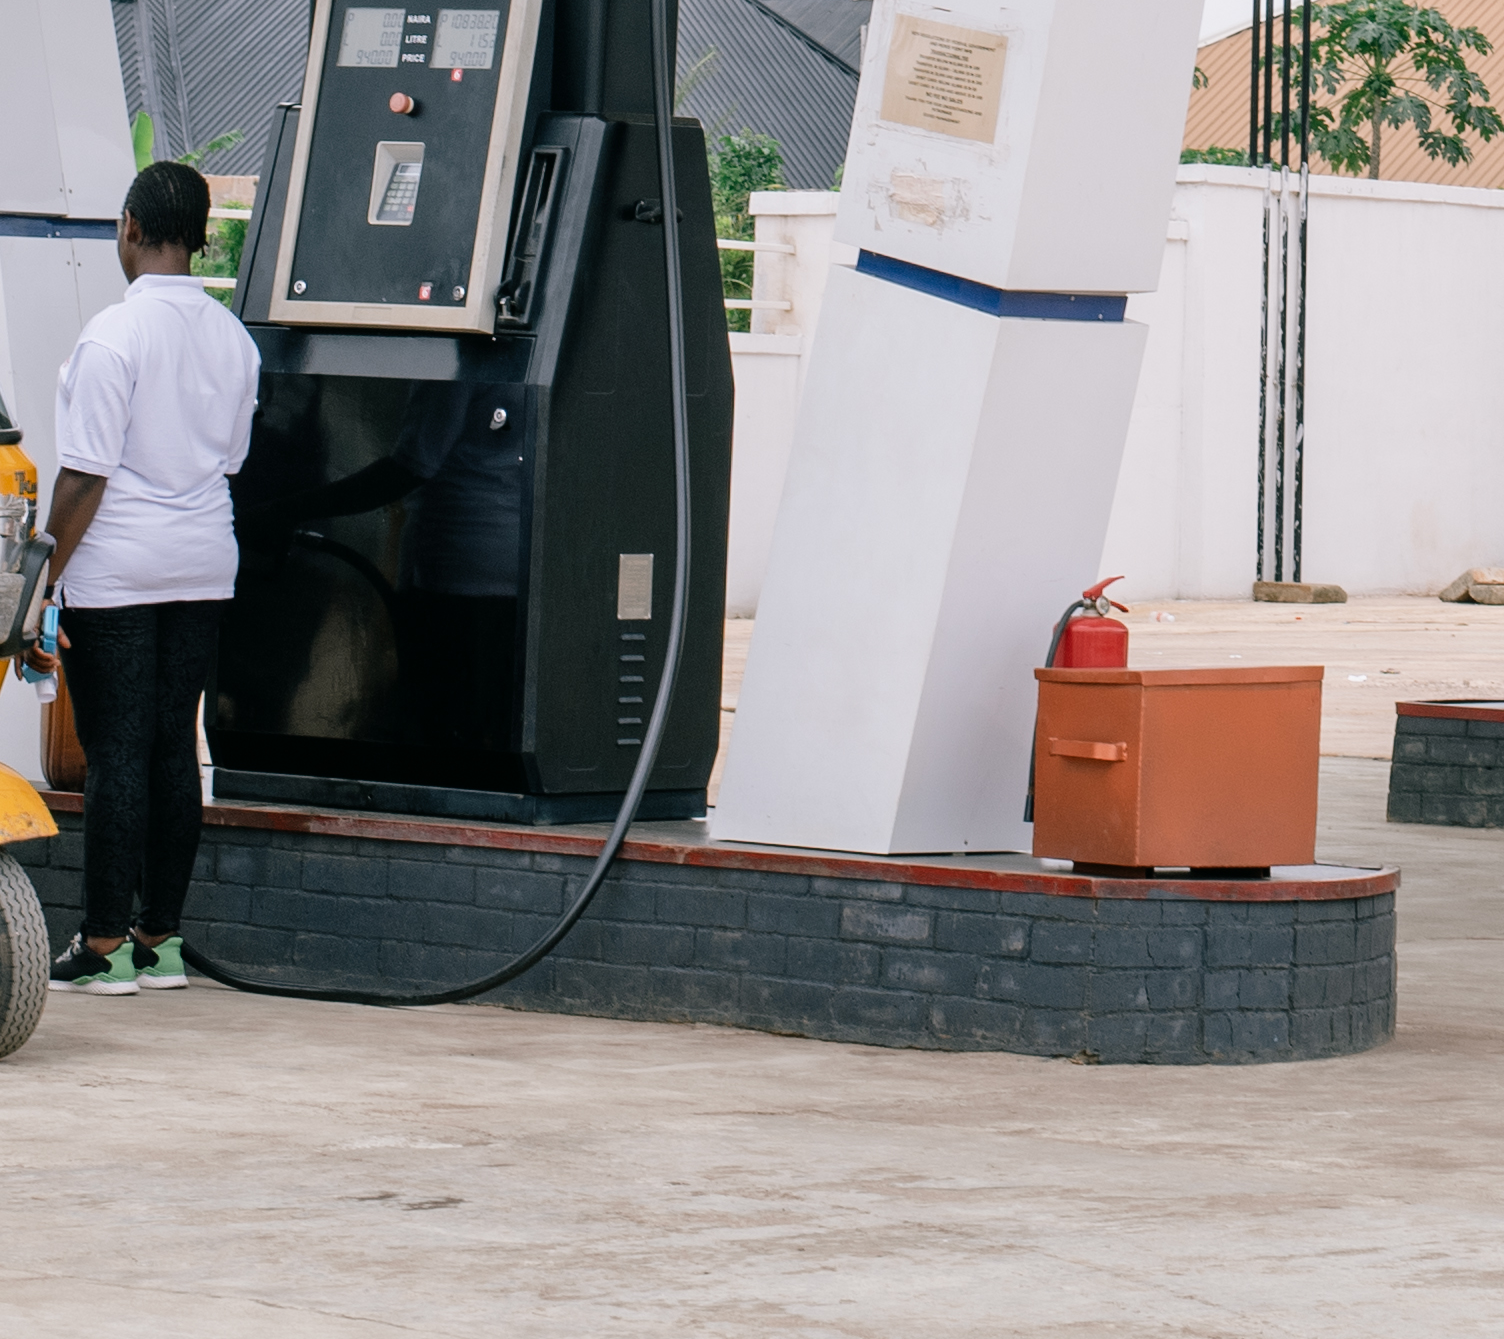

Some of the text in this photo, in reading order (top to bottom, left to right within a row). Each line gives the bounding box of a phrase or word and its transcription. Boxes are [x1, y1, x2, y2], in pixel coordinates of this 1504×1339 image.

[407, 15, 432, 24] NAIRA
[404, 35, 428, 44] LITRE
[401, 54, 425, 63] PRICE
